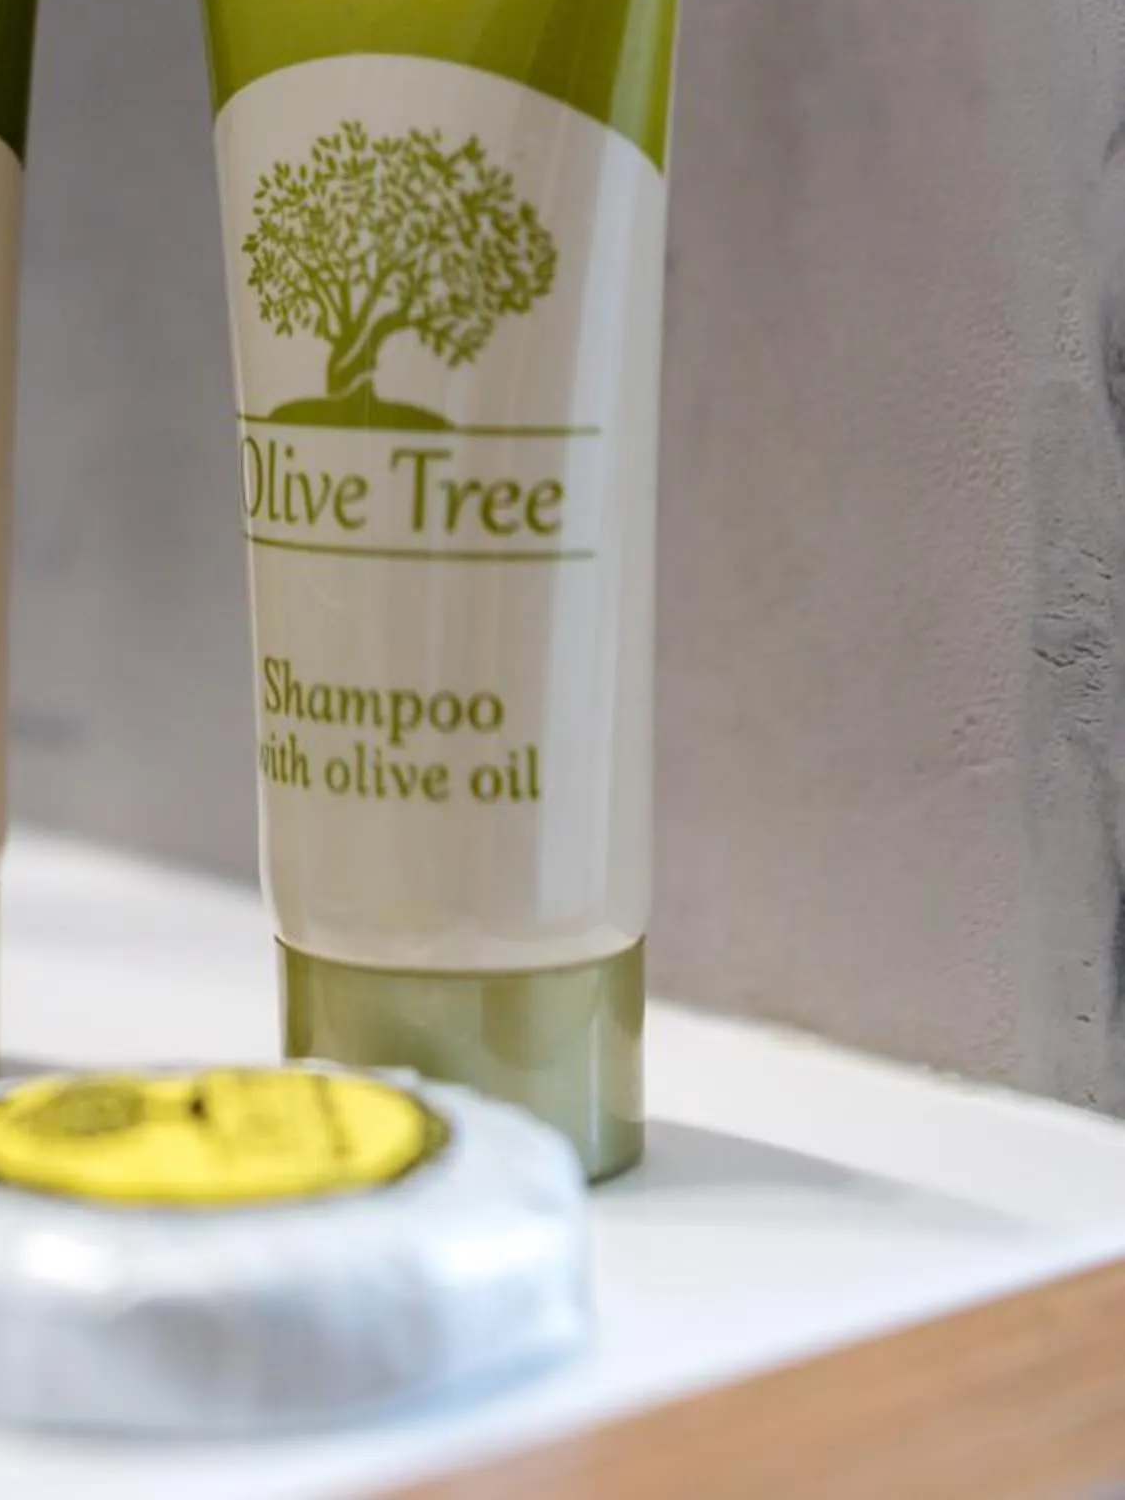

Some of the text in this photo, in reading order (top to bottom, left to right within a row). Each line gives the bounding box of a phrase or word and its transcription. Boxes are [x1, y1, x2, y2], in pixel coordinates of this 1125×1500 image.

[241, 436, 565, 536] Olive Tree
[264, 657, 505, 745] Shampoo
[324, 743, 450, 801] olive
[468, 745, 540, 802] oil
